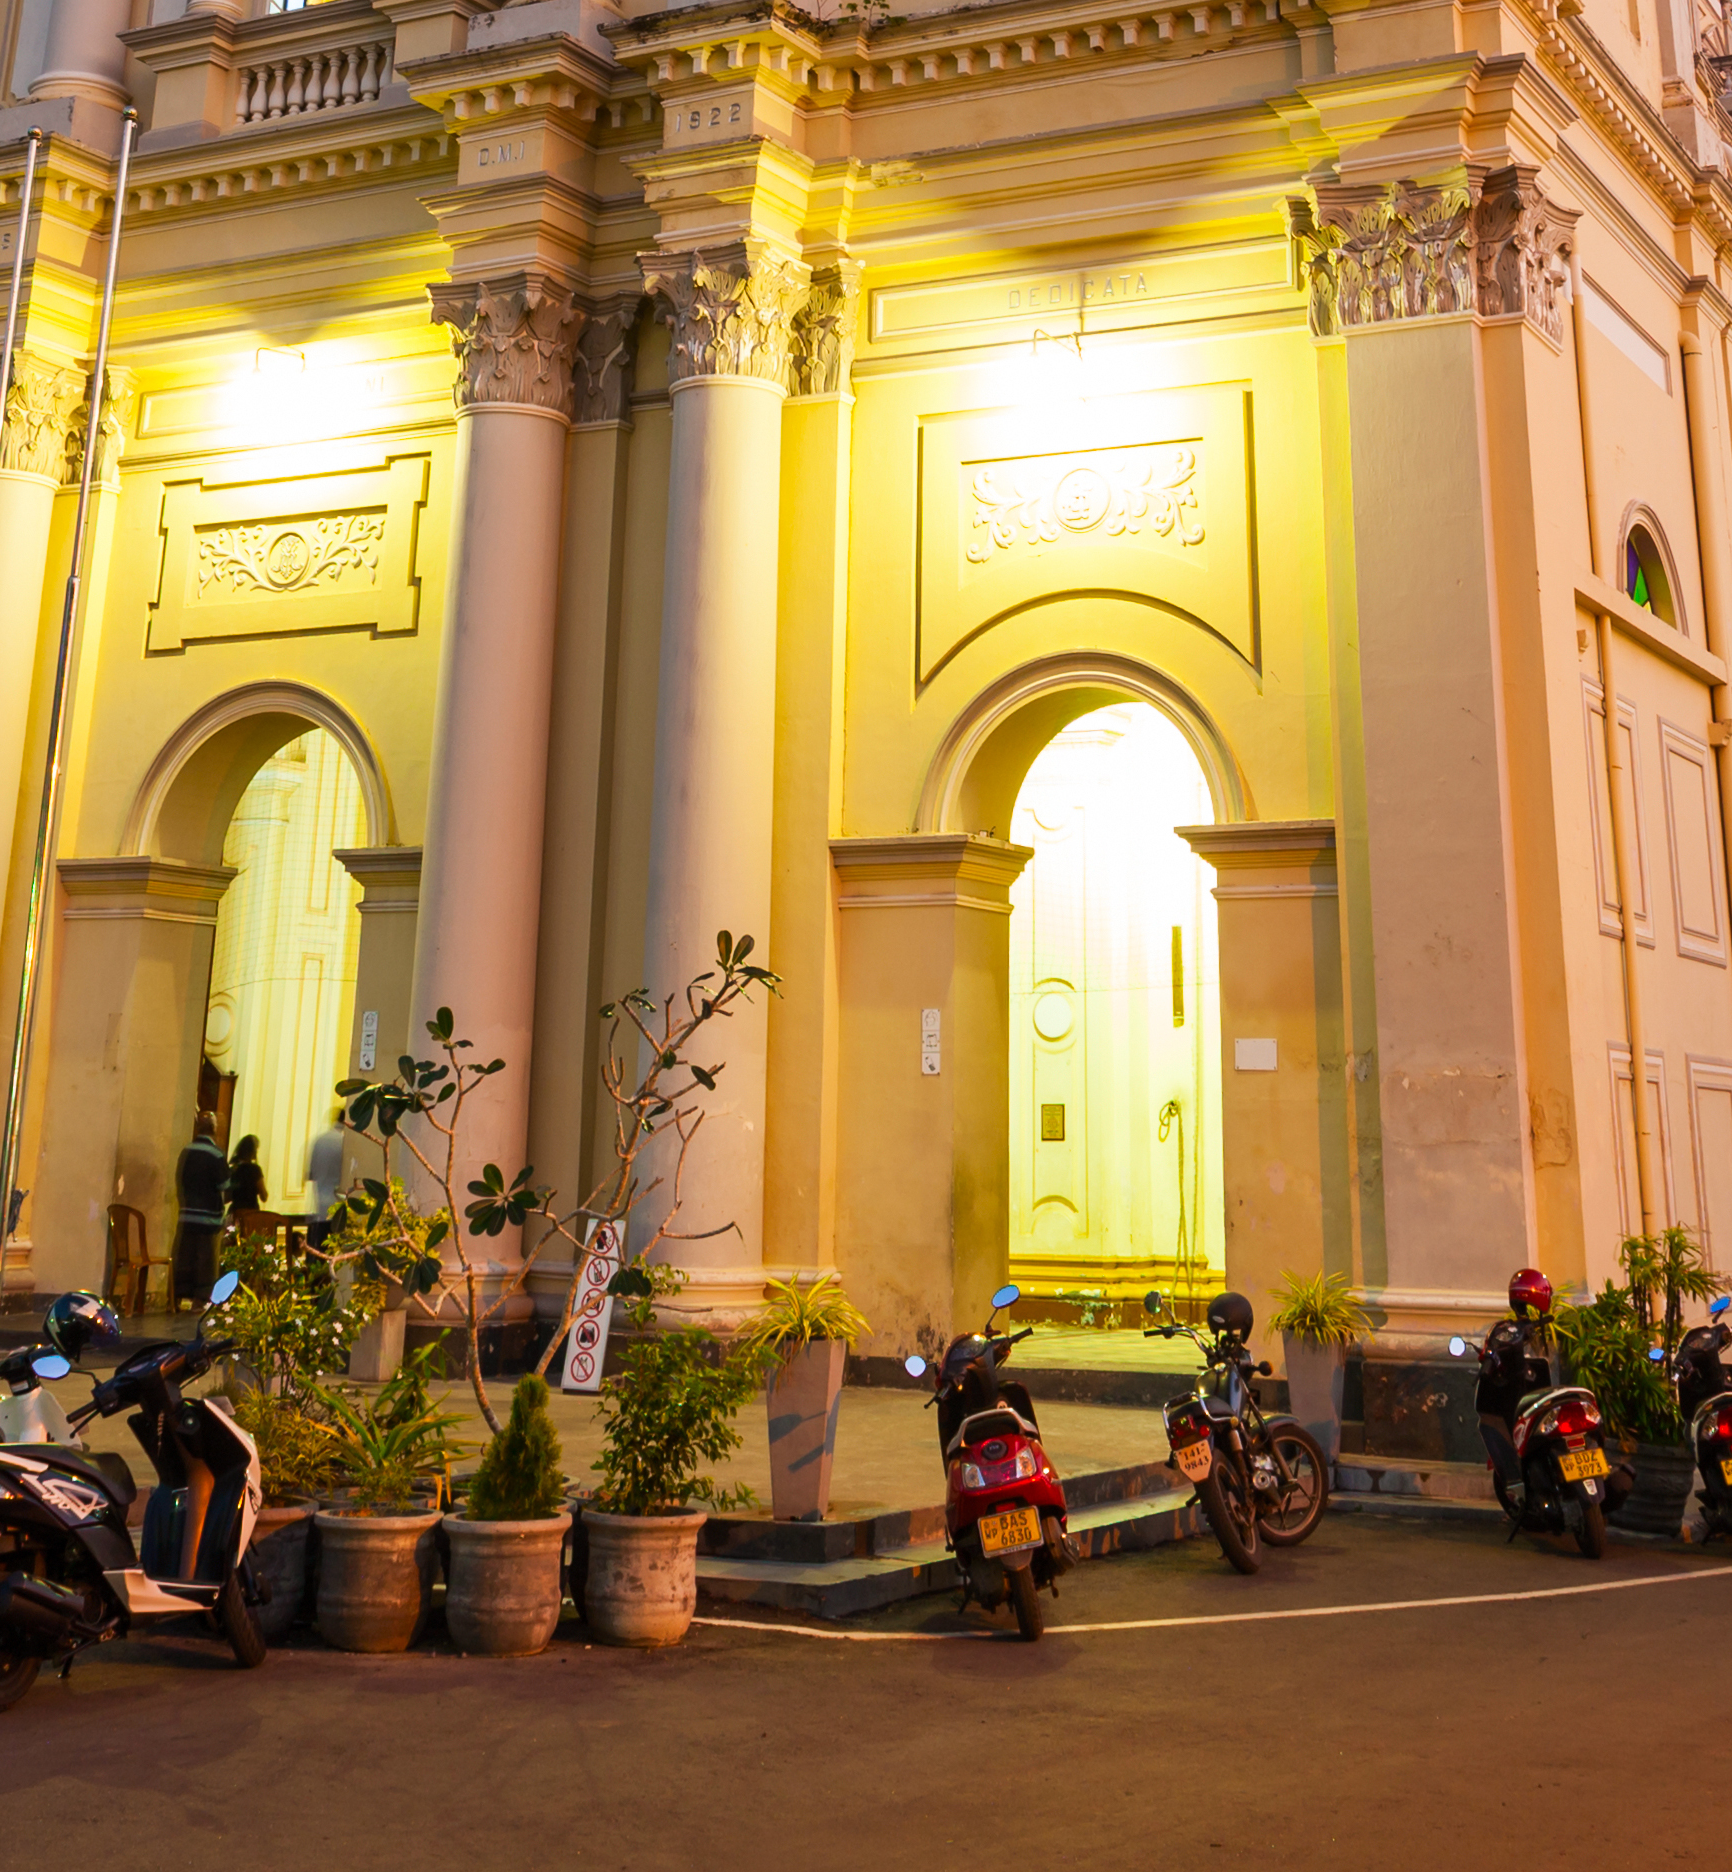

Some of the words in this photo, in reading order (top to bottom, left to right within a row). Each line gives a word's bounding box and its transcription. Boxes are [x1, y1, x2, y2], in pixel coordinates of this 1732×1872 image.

[676, 102, 741, 133] 1922
[1008, 272, 1147, 310] DEDICATA
[999, 1512, 1027, 1530] BAS
[984, 1529, 998, 1540] WP
[1001, 1526, 1032, 1546] 6830
